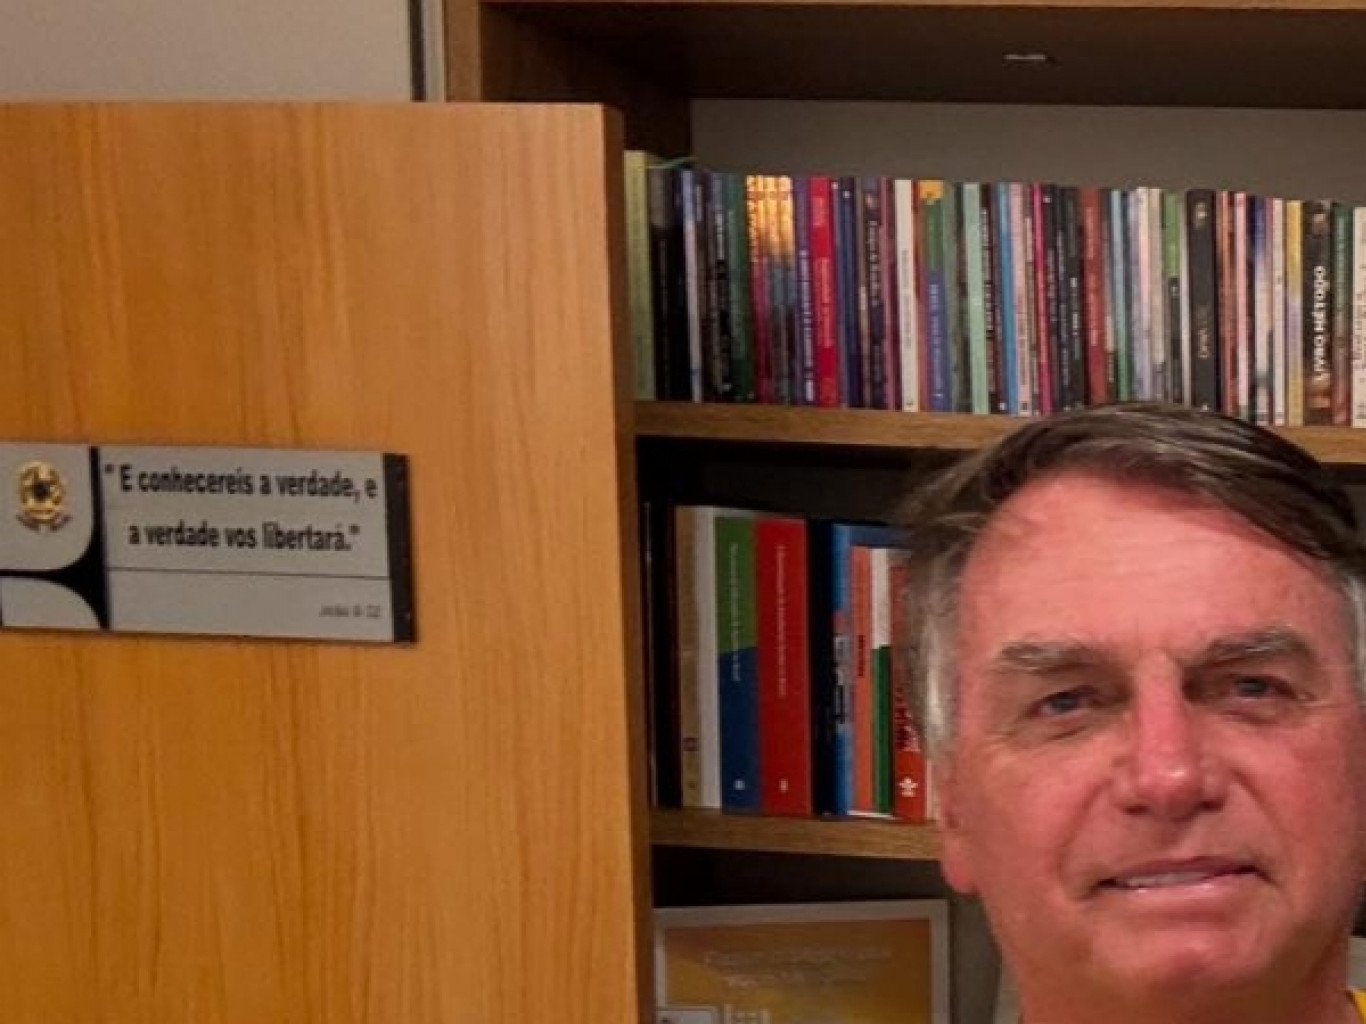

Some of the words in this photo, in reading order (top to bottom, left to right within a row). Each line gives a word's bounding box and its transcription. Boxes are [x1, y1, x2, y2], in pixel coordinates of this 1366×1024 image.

[259, 474, 272, 495] a
[276, 468, 362, 504] verdade,
[364, 477, 378, 500] e
[127, 524, 141, 546] a
[144, 518, 220, 547] verdade
[224, 526, 257, 549] vos
